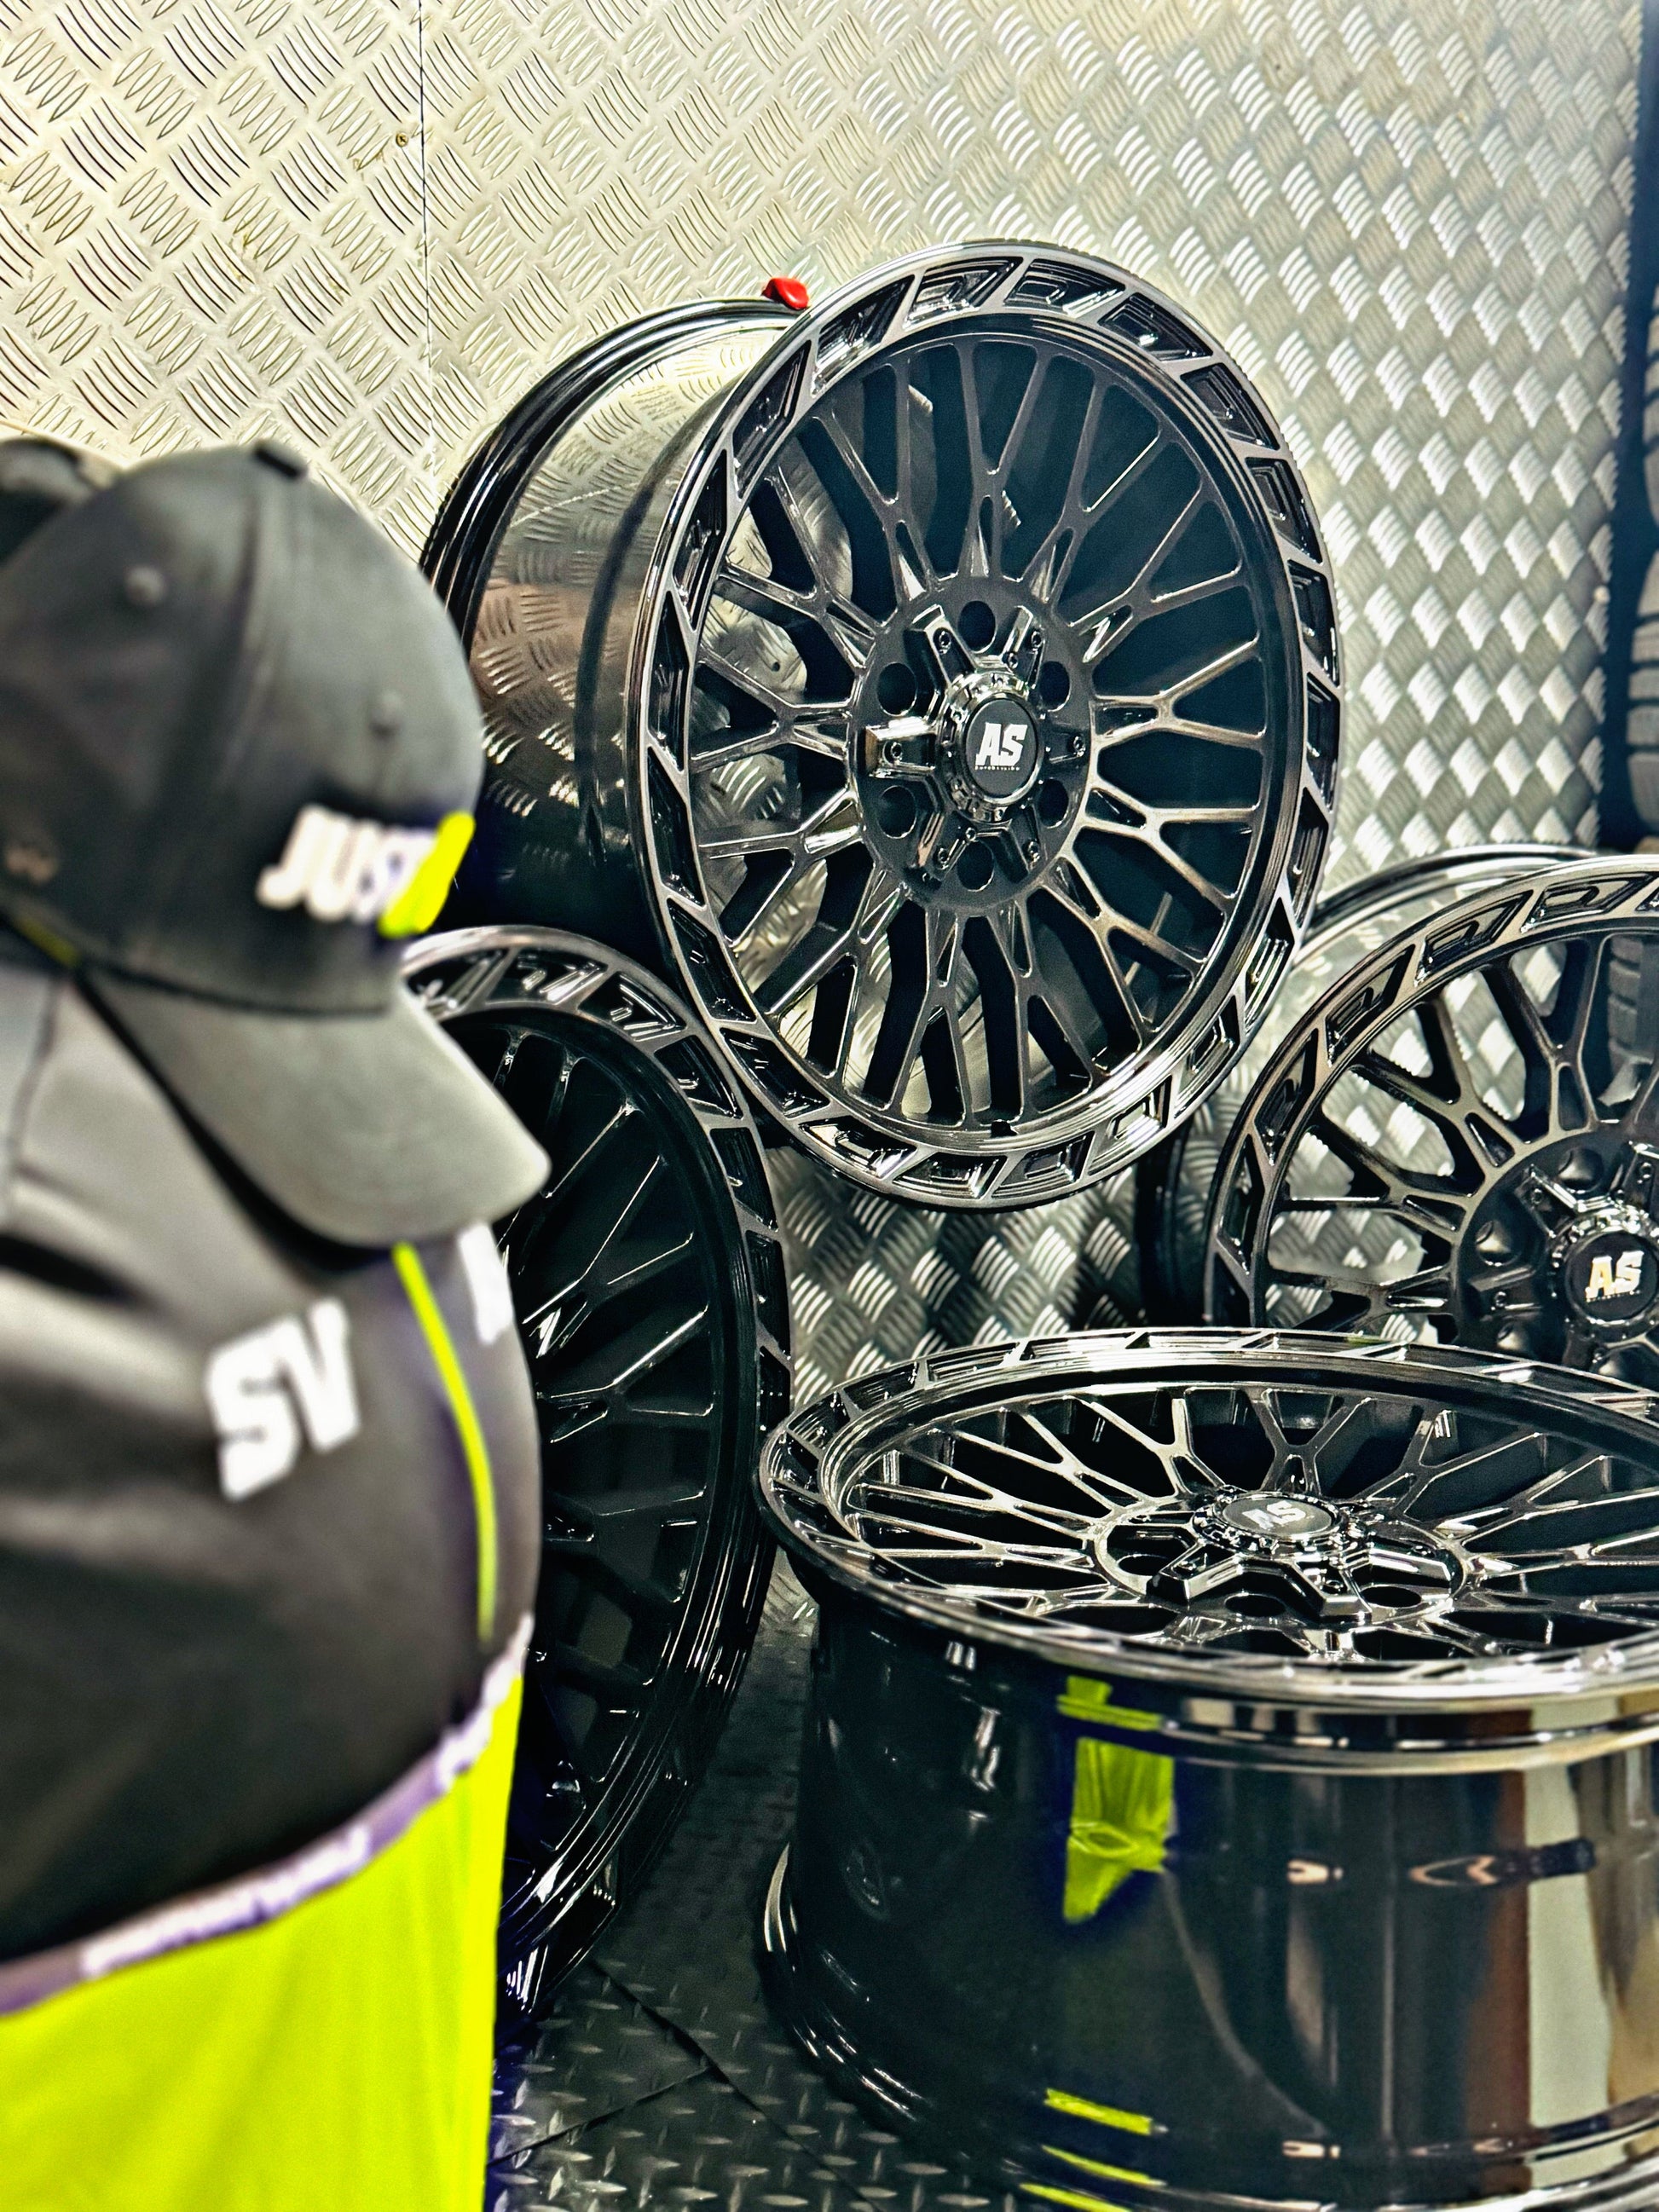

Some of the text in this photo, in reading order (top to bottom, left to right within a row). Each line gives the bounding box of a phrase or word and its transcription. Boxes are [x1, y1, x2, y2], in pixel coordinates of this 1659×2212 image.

[975, 721, 1027, 766] AS
[1585, 1250, 1645, 1299] AS
[1242, 1500, 1306, 1531] AS
